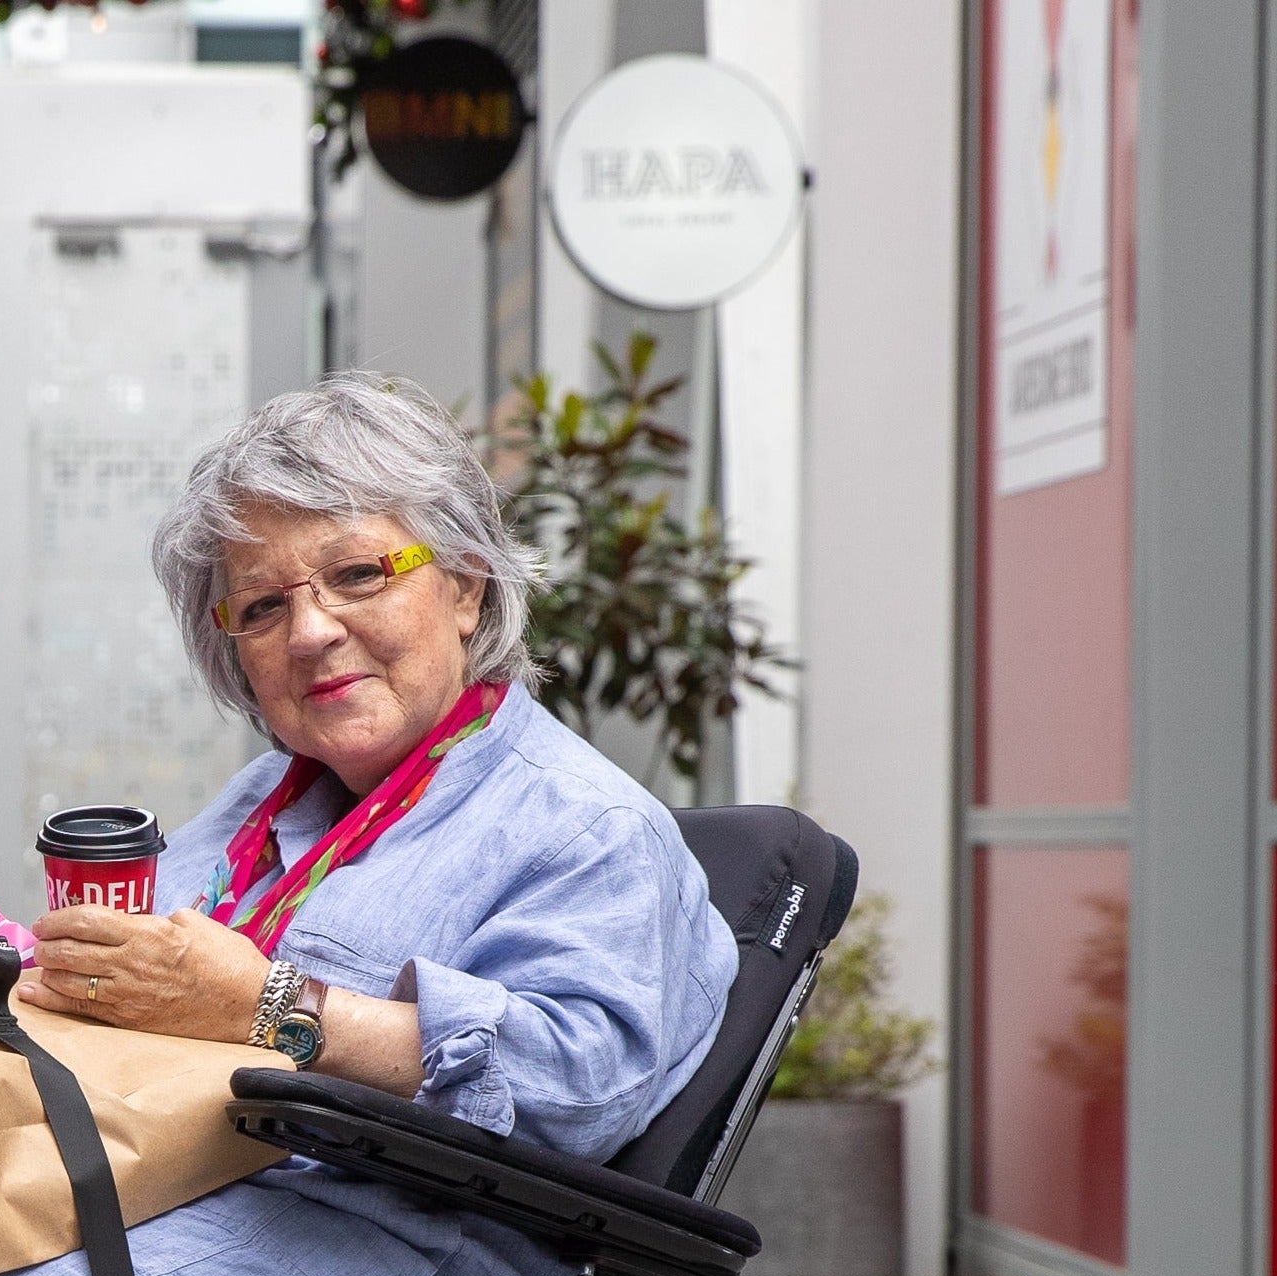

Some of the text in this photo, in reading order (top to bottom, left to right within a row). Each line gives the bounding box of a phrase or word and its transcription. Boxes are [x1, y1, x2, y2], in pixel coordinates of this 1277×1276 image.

[581, 144, 772, 201] HAPA
[82, 876, 150, 914] DELI
[770, 884, 805, 949] permobil
